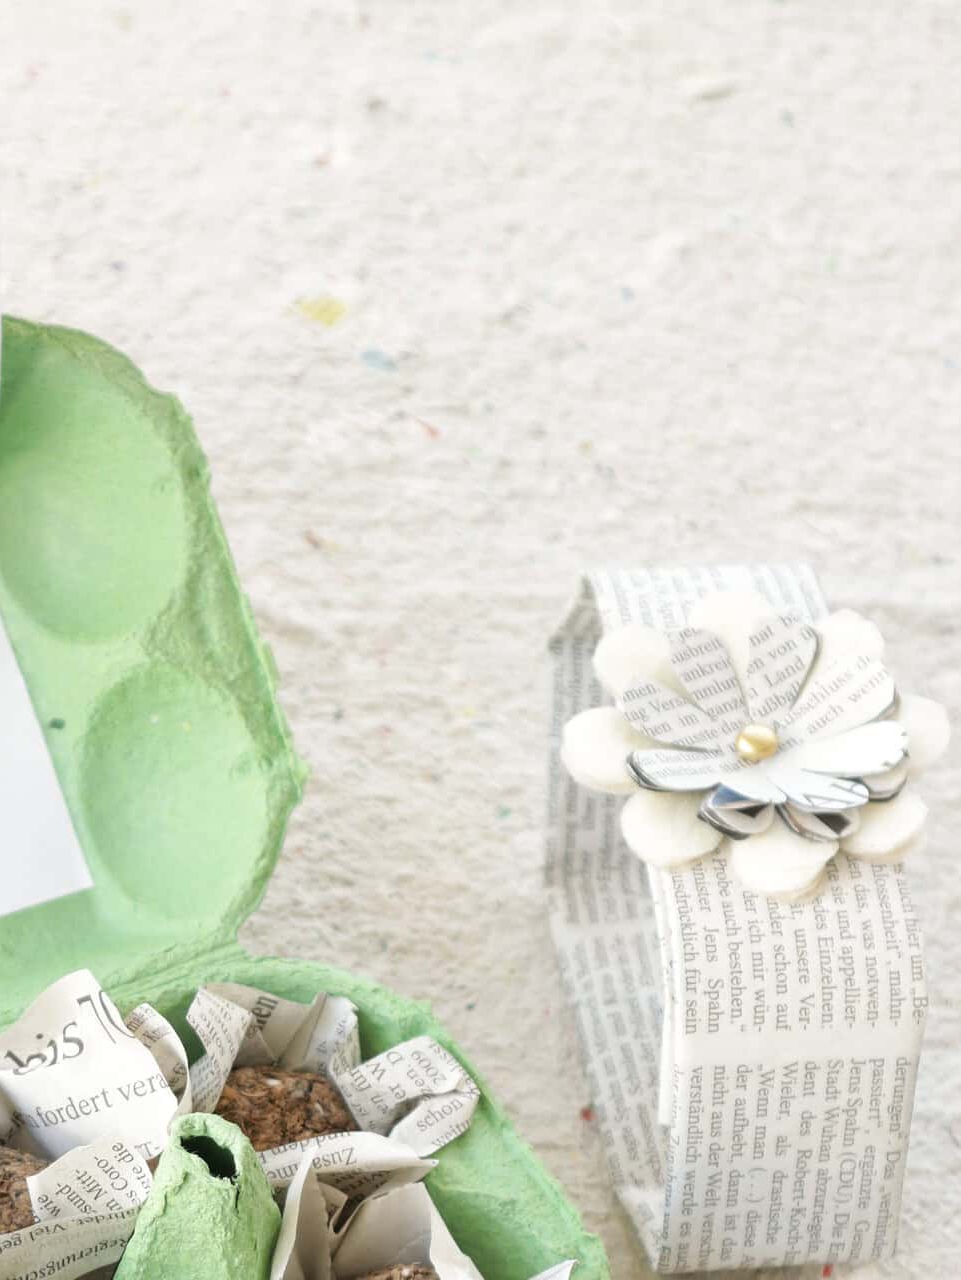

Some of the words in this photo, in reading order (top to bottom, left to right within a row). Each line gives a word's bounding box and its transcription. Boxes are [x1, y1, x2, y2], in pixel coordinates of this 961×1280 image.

[416, 1091, 463, 1132] schon
[112, 1143, 134, 1163] die
[94, 1156, 128, 1191] Coro-
[38, 1194, 61, 1219] wie
